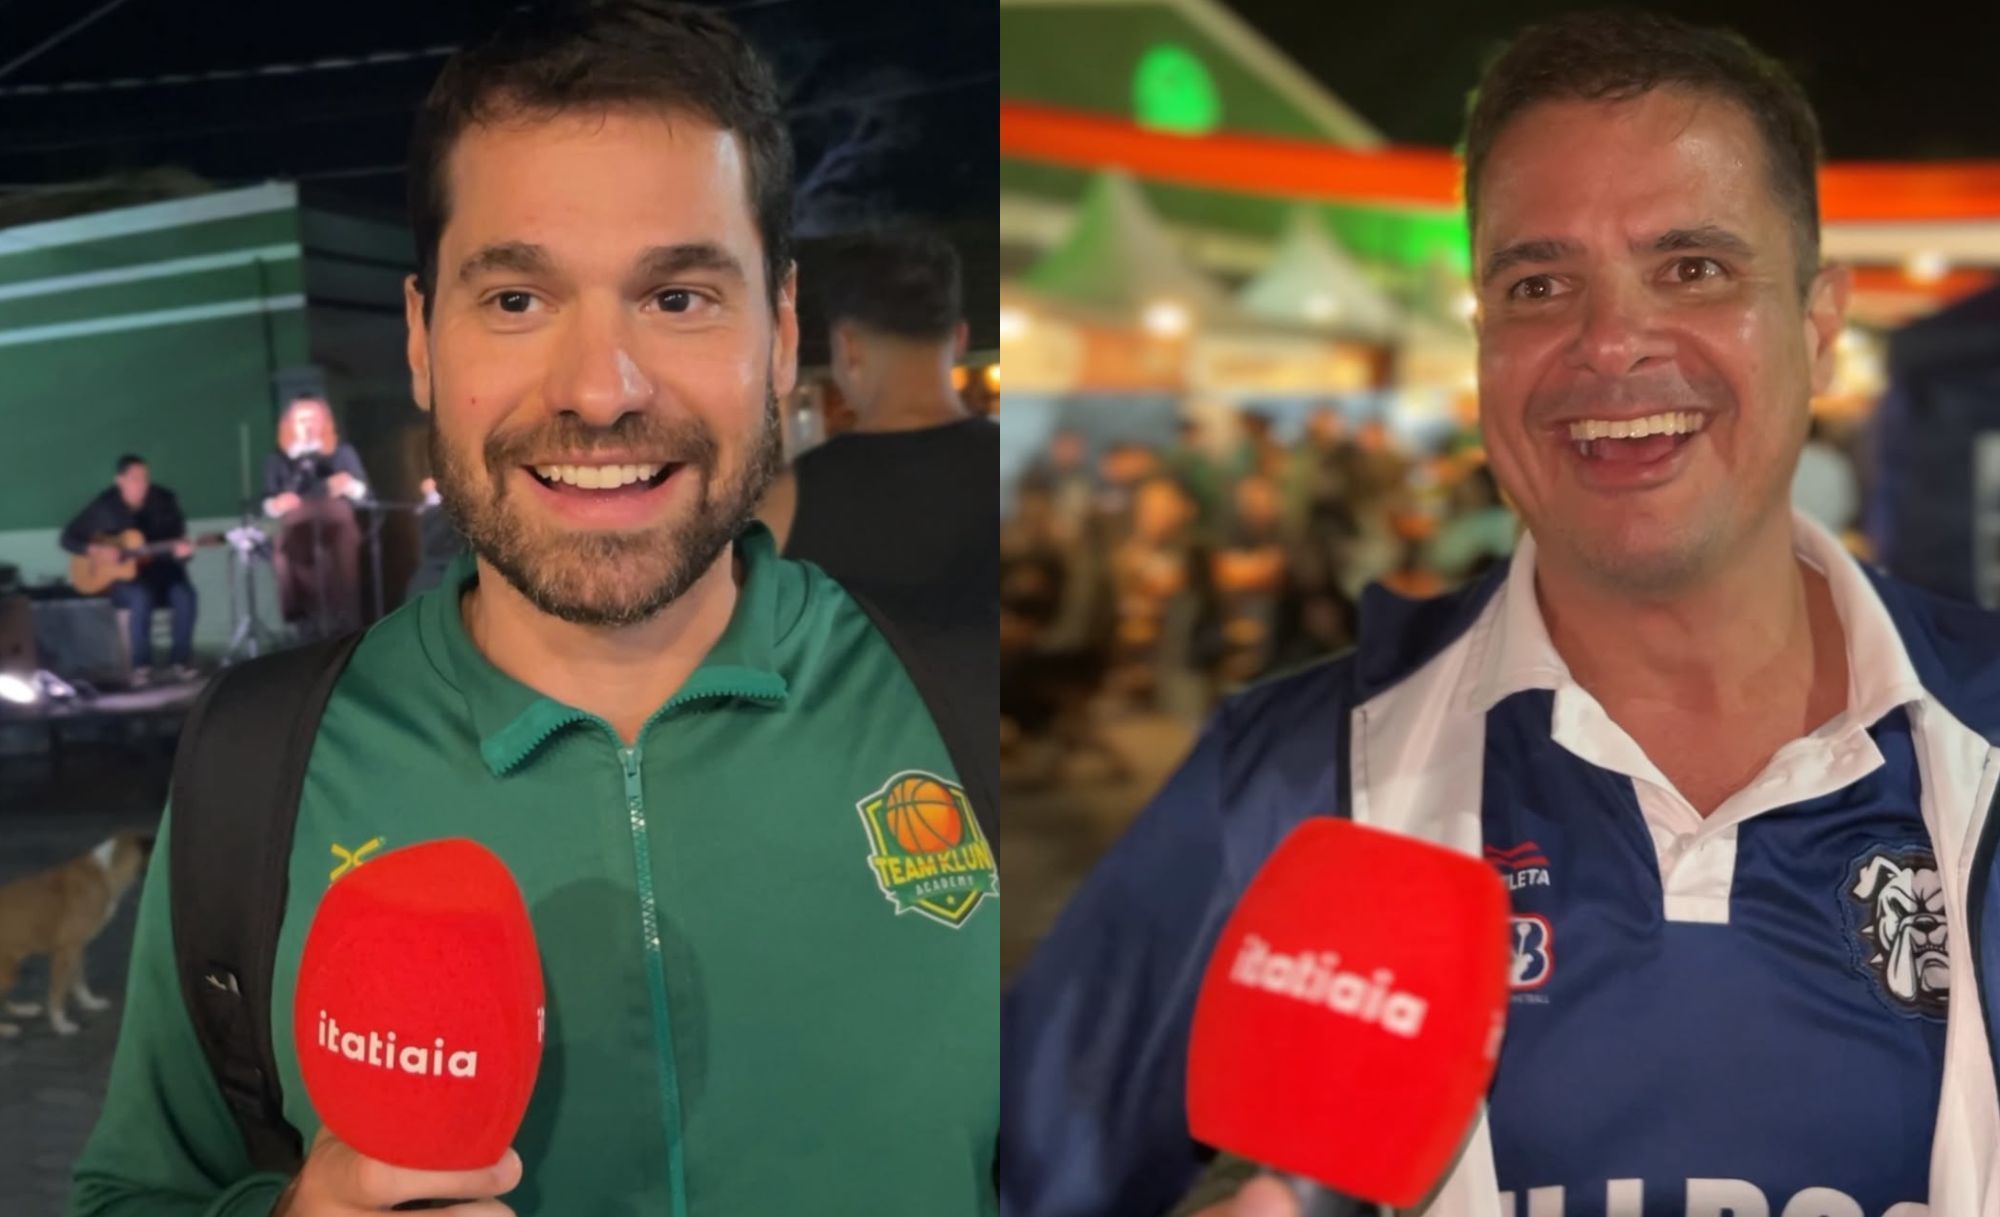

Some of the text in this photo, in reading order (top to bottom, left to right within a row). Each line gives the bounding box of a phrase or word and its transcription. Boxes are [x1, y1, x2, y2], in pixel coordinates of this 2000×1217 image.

[874, 841, 992, 887] TEAM KLUN
[915, 875, 974, 896] ACADEMY
[1229, 933, 1428, 1038] itatiaia
[318, 1009, 478, 1078] itatiaia
